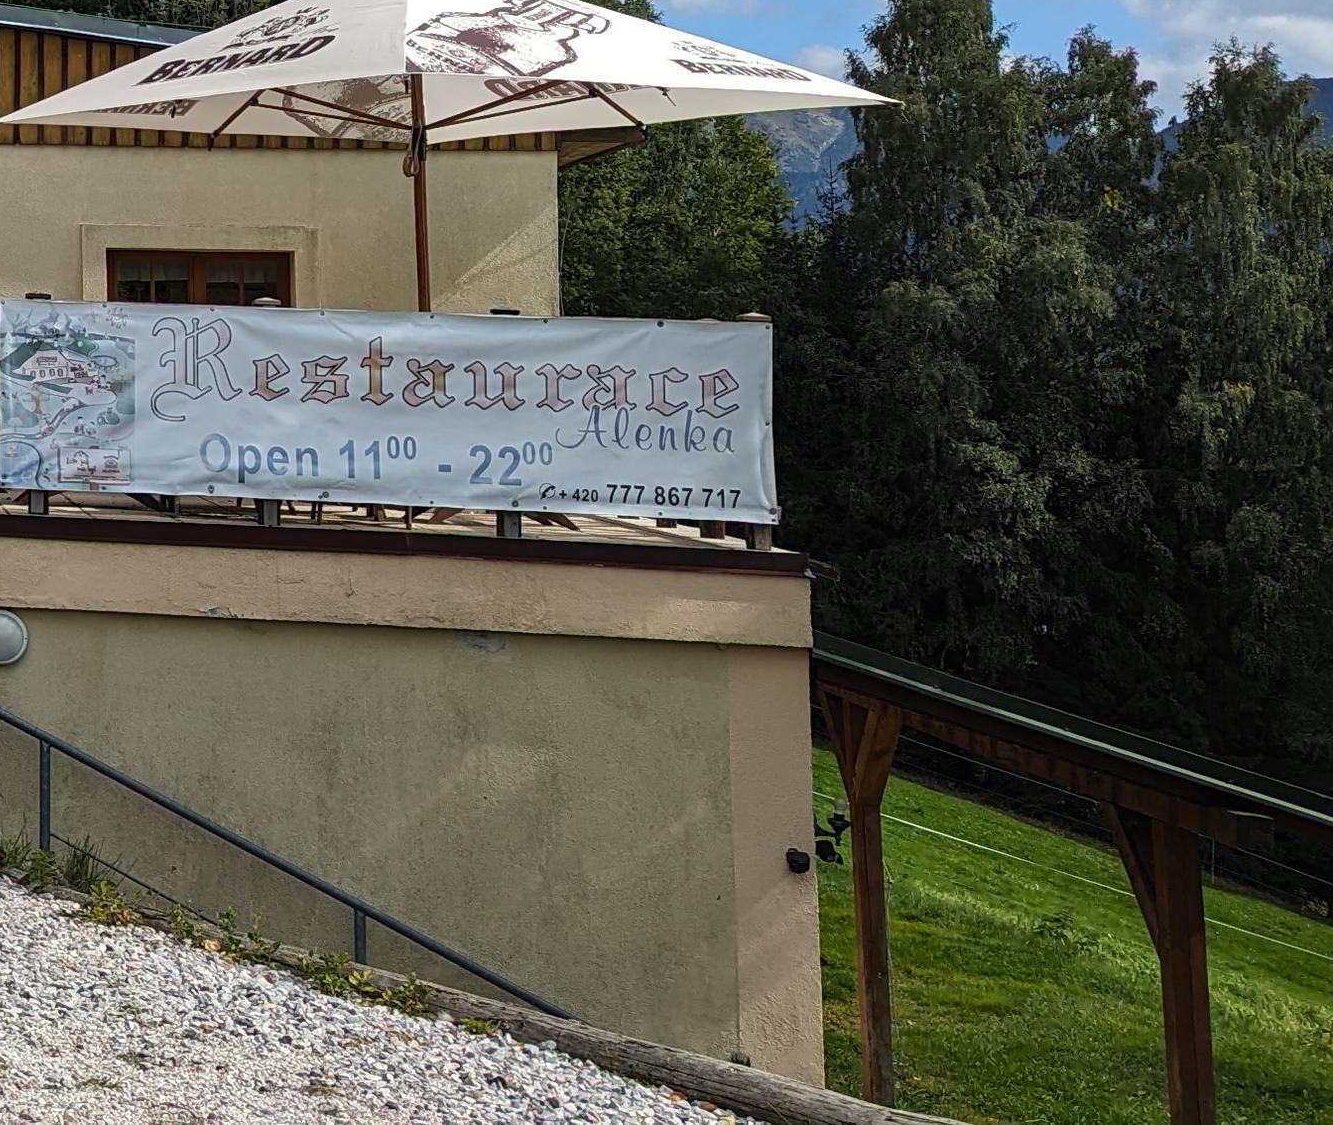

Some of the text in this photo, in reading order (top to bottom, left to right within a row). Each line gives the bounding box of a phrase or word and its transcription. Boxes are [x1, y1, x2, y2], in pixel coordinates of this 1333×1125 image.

[133, 34, 336, 86] BERNARD
[670, 59, 812, 81] BERNARD
[151, 316, 739, 422] Restaurace
[555, 405, 735, 453] Alenka
[199, 433, 319, 483] Open
[438, 464, 452, 473] -
[572, 488, 600, 503] 420
[606, 483, 646, 504] 777
[654, 485, 694, 507] 867
[702, 488, 742, 509] 717
